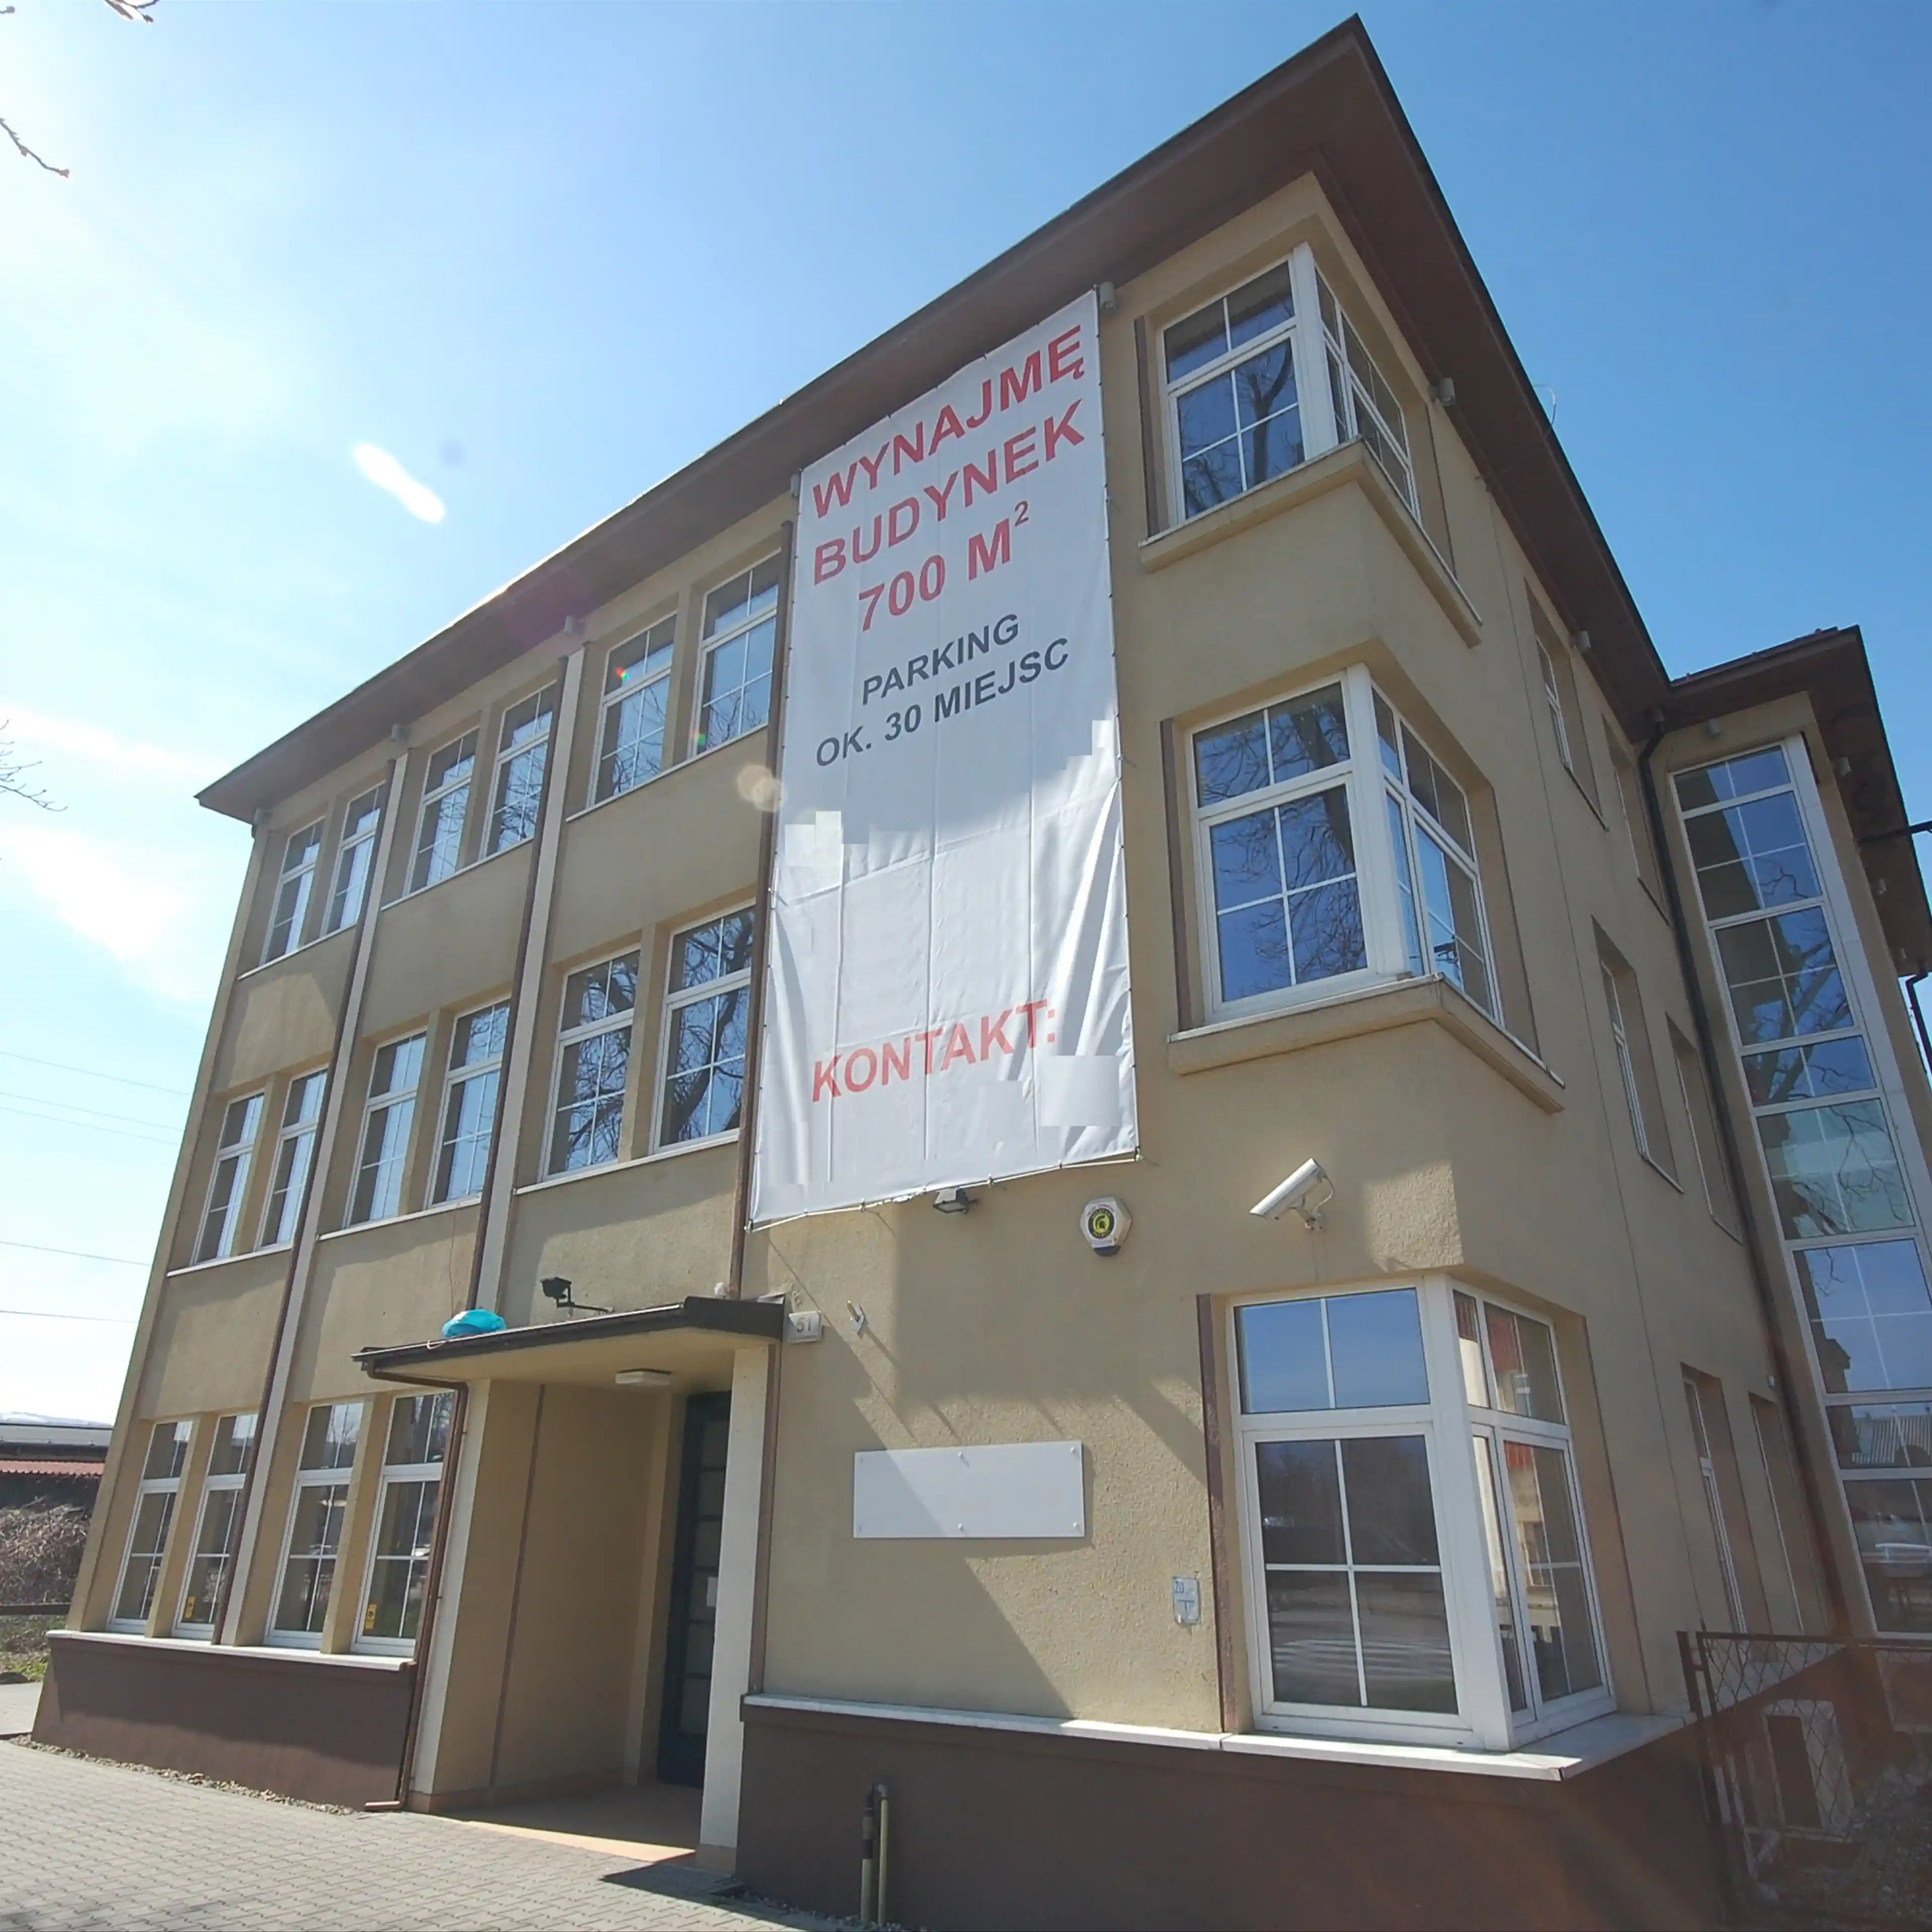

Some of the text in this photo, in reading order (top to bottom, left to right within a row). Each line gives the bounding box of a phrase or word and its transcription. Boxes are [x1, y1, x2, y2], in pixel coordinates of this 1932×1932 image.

[812, 325, 1085, 519] WYNAJMĘ
[814, 398, 1085, 586] BUDYNEK
[858, 554, 946, 632] 700
[816, 637, 1069, 767] OK. 30 MIEJSC
[862, 613, 1019, 706] PARKING
[812, 999, 1057, 1103] KONTAKT:
[796, 1316, 812, 1333] 51
